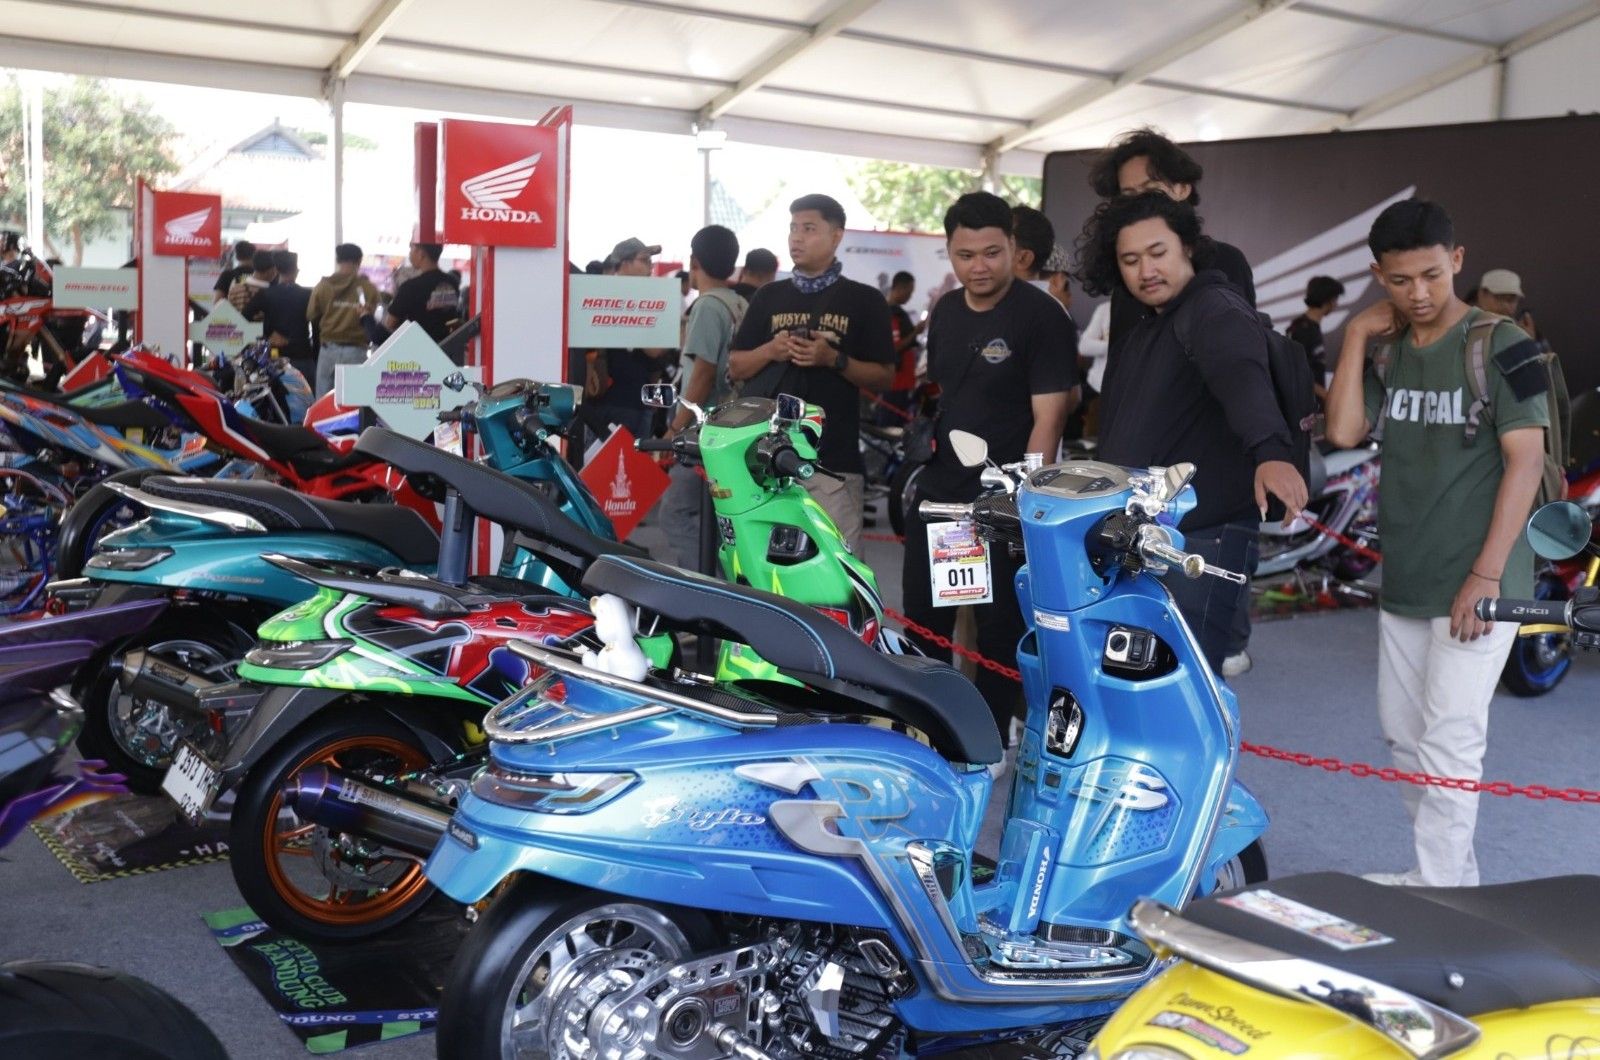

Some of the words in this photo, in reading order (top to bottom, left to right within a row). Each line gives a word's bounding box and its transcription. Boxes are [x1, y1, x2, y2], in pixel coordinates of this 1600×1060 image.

[460, 207, 543, 224] HONDA
[164, 235, 212, 247] HONDA
[581, 298, 626, 311] MATIC
[637, 300, 667, 312] CUB
[591, 315, 658, 328] ADVANCE
[771, 312, 849, 334] MUSYARAH
[604, 498, 637, 511] Honda
[948, 567, 974, 587] 011
[1026, 859, 1049, 919] HONDA
[252, 942, 325, 1009] BANDUNG
[303, 974, 347, 1005] CLUB
[397, 1011, 438, 1020] STY
